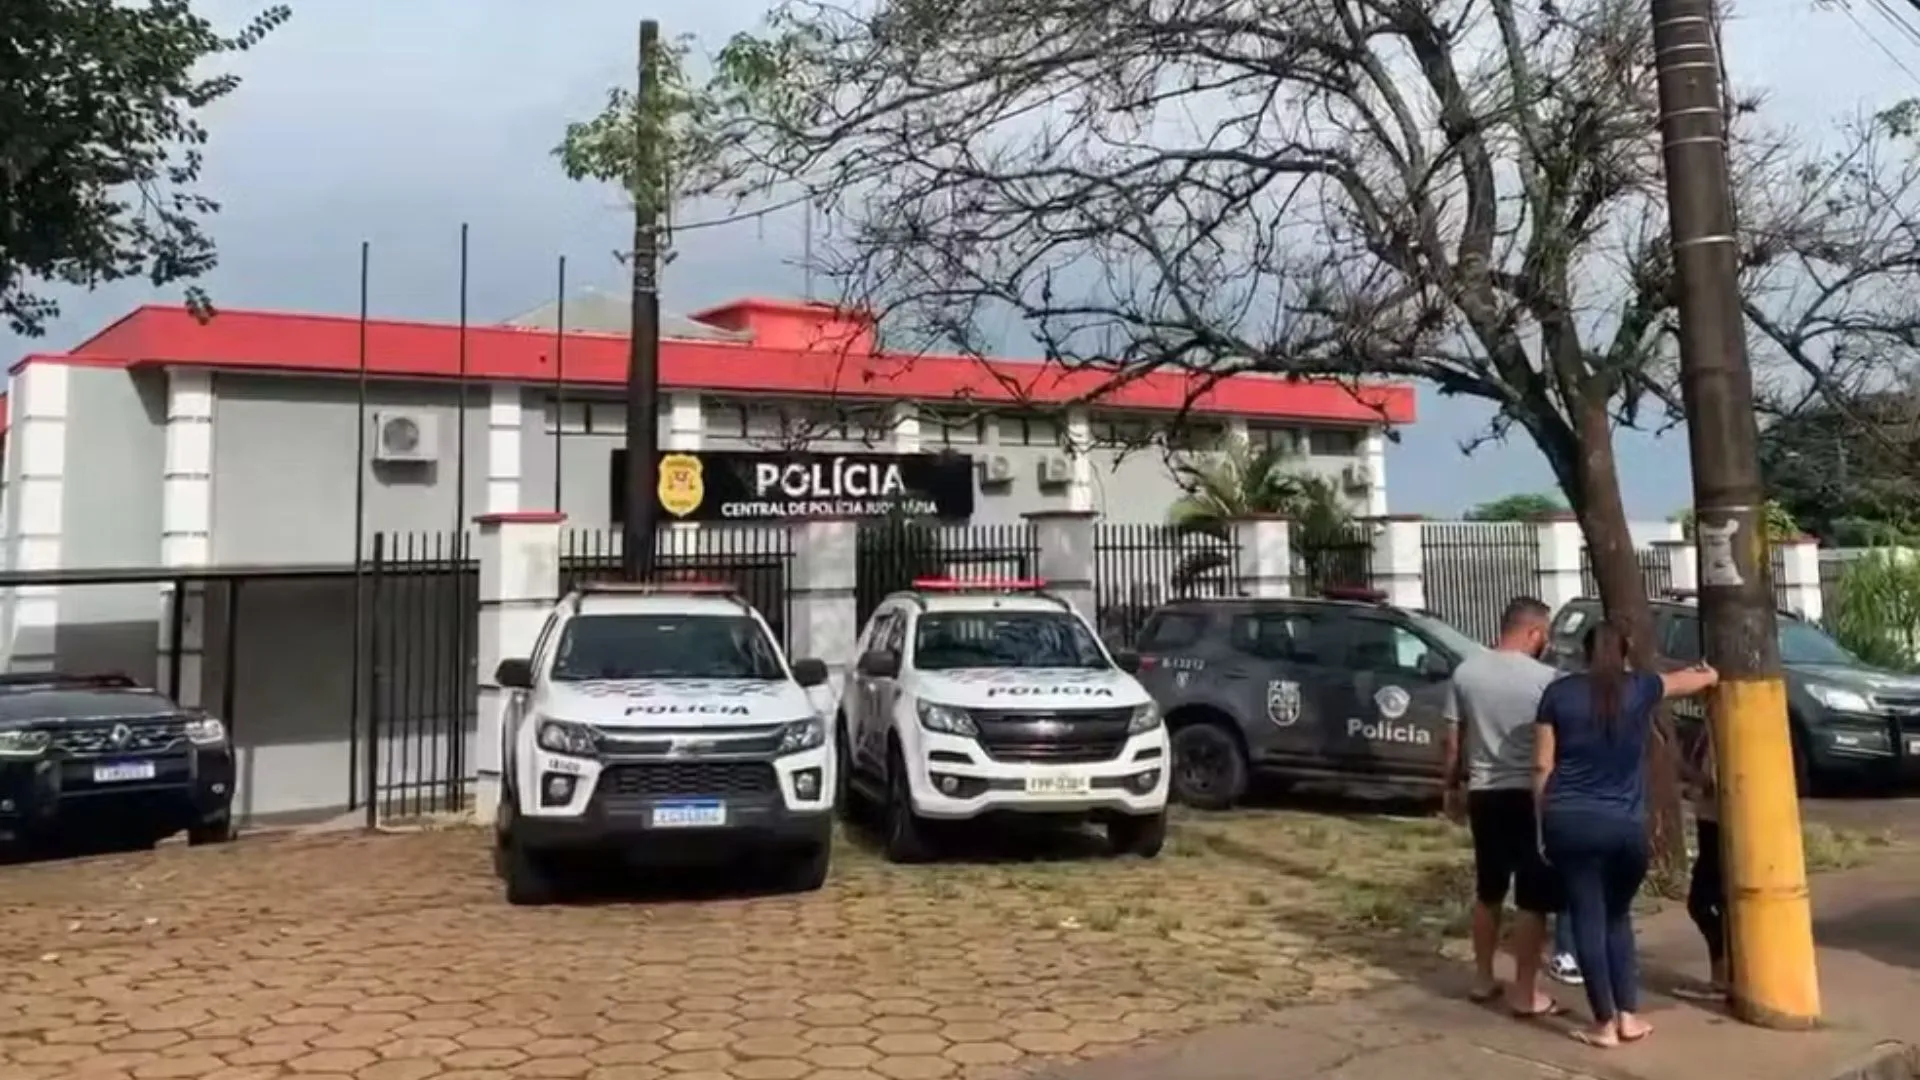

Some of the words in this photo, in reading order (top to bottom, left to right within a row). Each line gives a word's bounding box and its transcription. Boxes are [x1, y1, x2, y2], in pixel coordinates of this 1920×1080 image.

[756, 457, 906, 496] POLÍCIA
[721, 501, 784, 517] CENTRAL
[788, 501, 806, 515] DE
[808, 498, 862, 516] POLÍCIA
